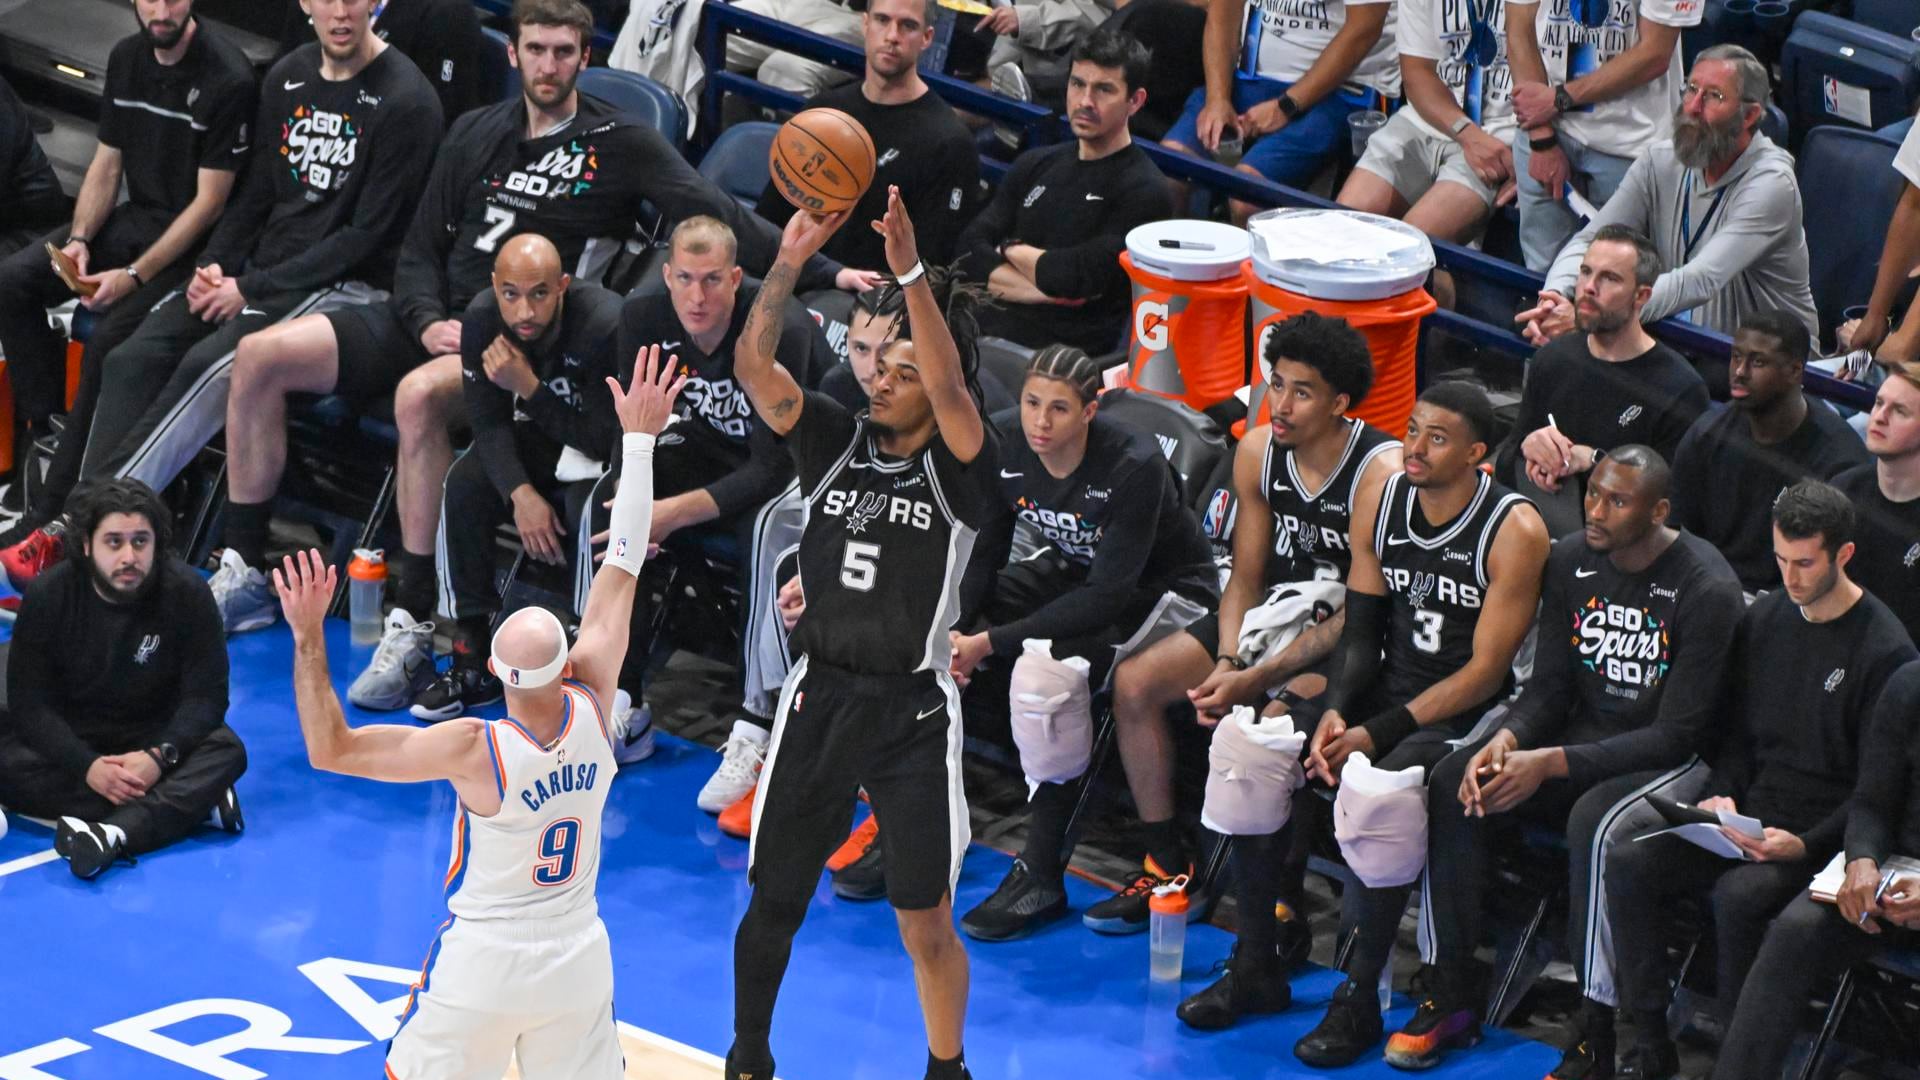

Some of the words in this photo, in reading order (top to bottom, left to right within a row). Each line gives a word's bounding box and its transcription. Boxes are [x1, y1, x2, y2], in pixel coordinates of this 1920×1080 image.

[1262, 15, 1329, 30] UNDER
[312, 110, 342, 136] GO
[288, 118, 357, 172] Spurs
[309, 163, 331, 190] GO
[505, 171, 549, 196] GO
[474, 205, 516, 253] 7
[1135, 300, 1169, 351] G
[823, 489, 933, 534] SPURS
[1038, 508, 1079, 532] GO
[840, 539, 881, 592] 5
[1445, 549, 1470, 563] LEDGER
[1382, 567, 1481, 608] SPURS
[1651, 585, 1677, 600] LEDGER
[1412, 610, 1445, 655] 3
[1579, 611, 1660, 664] Spurs
[1607, 604, 1643, 631] GO
[1606, 658, 1642, 684] GO
[521, 763, 598, 812] CARUSO
[532, 816, 582, 887] 9
